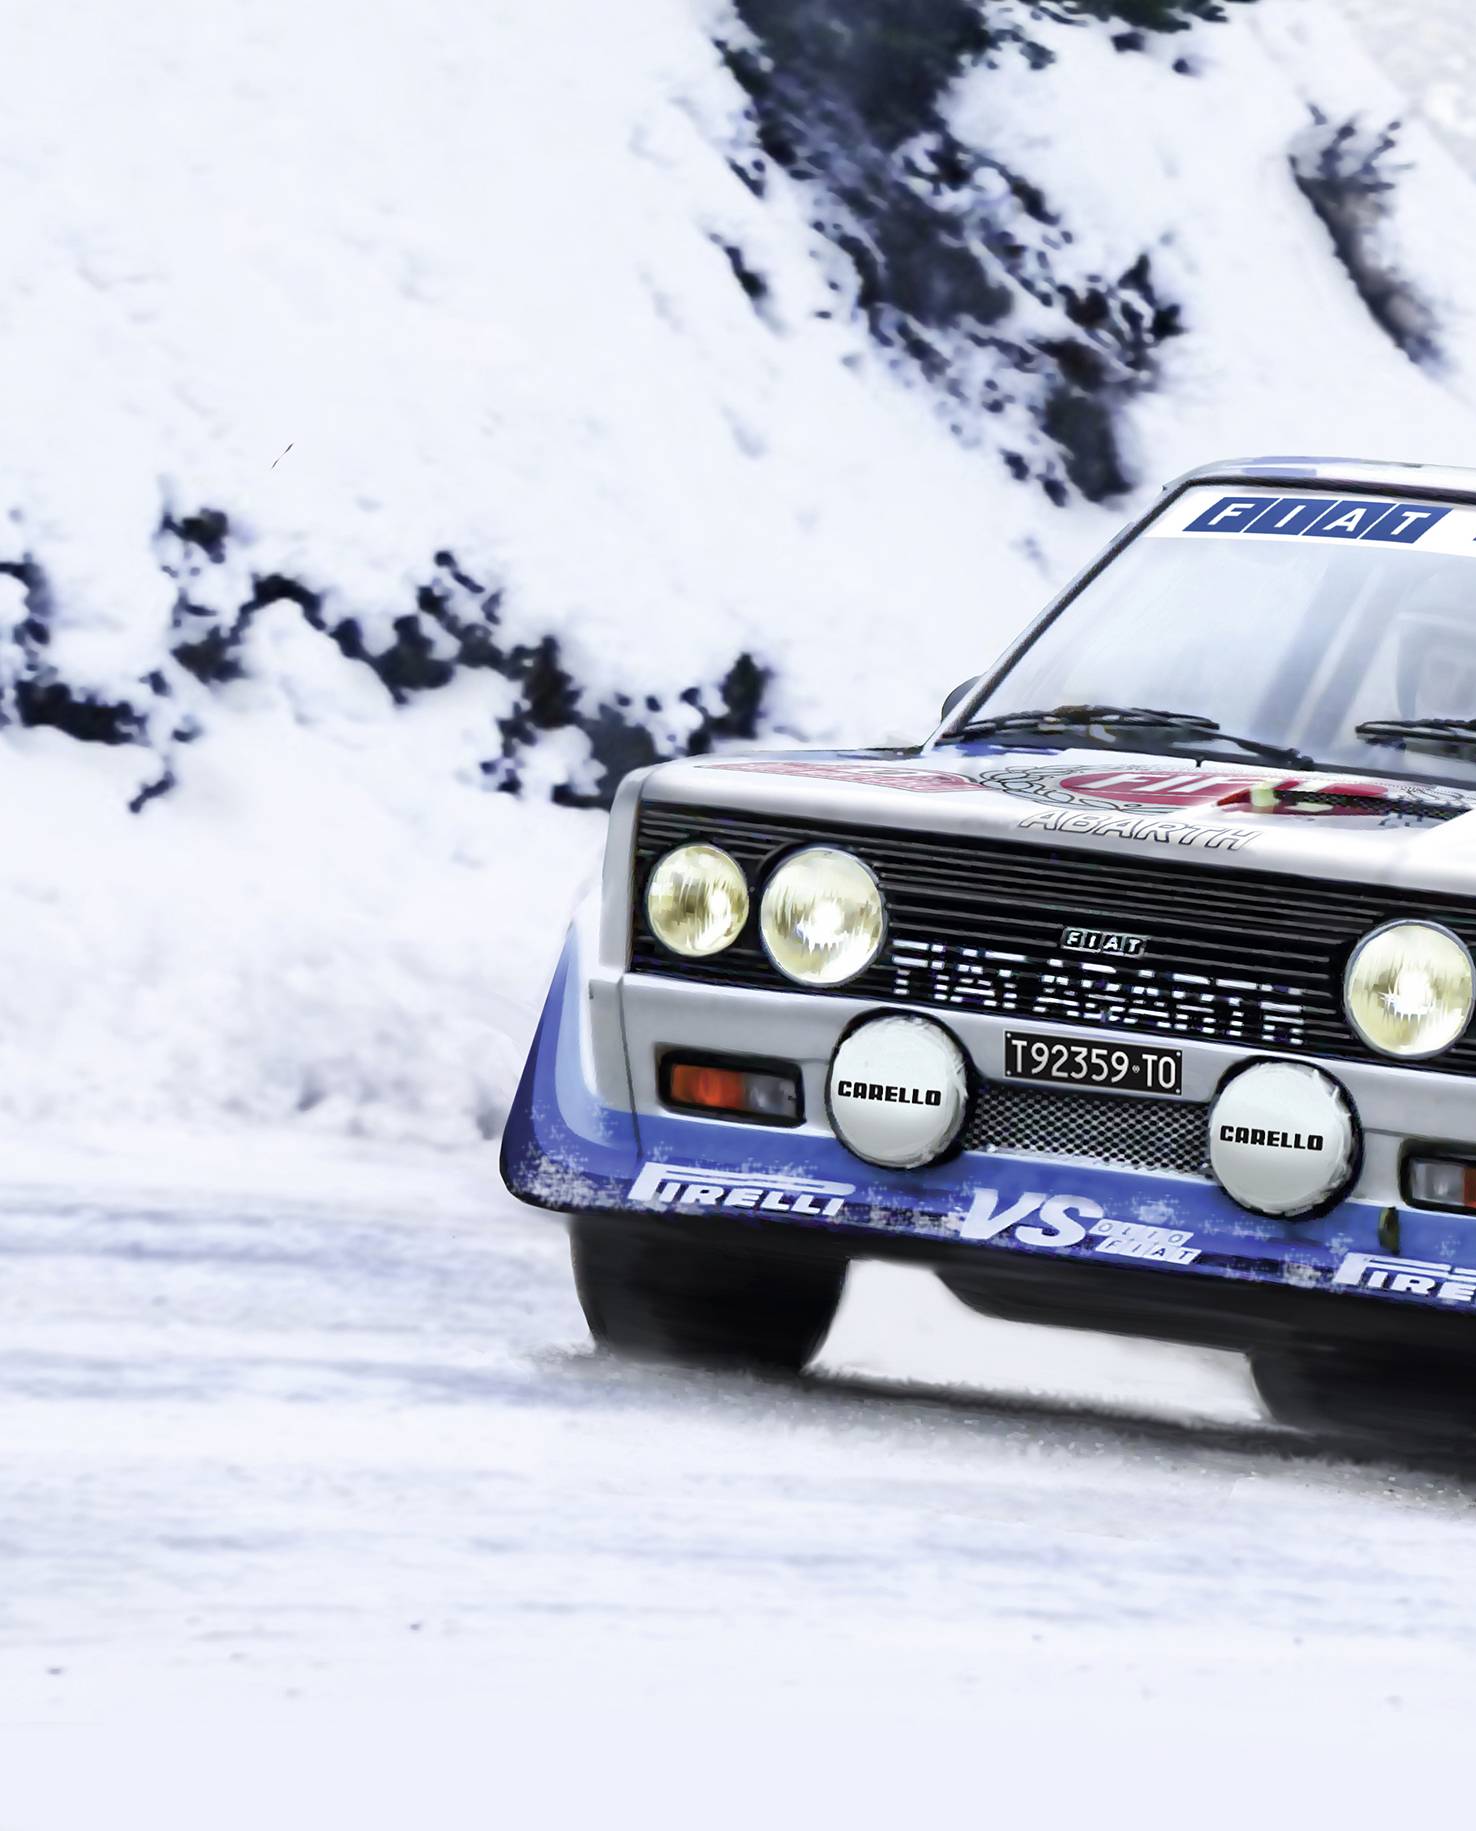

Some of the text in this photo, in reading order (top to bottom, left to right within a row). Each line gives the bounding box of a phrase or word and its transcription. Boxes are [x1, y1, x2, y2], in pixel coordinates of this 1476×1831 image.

[1204, 502, 1429, 539] FIAT
[1020, 810, 1262, 850] ABARTH
[1066, 930, 1140, 952] FIAT
[892, 939, 1304, 1046] FIAT ABARTH
[1012, 1038, 1176, 1090] T92359 TO
[837, 1080, 942, 1106] CARELLO
[1220, 1125, 1323, 1152] CARELLO
[628, 1162, 856, 1217] PIRELLI
[958, 1187, 1104, 1247] VS
[1104, 1239, 1194, 1260] FIAT
